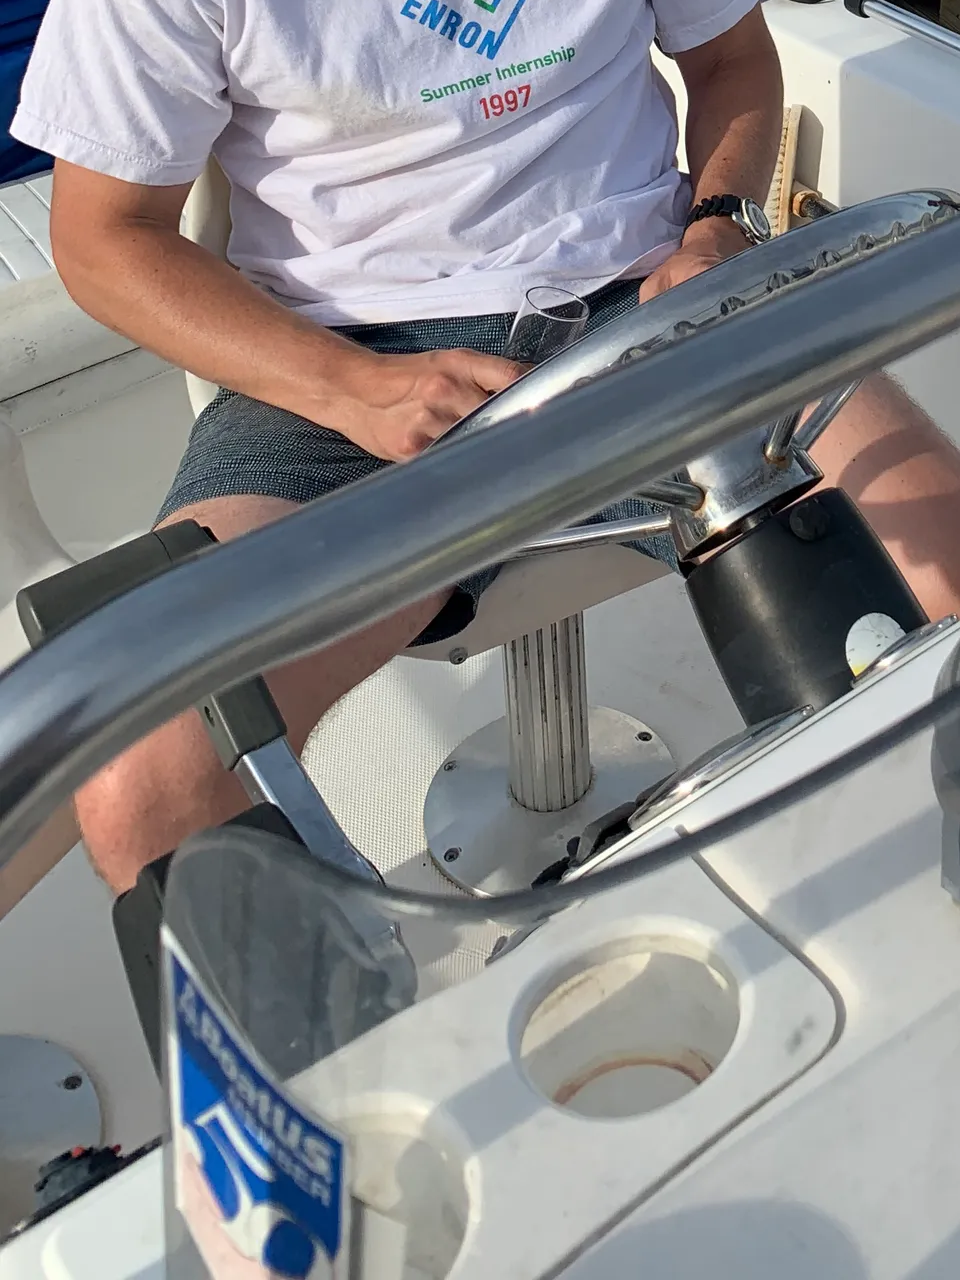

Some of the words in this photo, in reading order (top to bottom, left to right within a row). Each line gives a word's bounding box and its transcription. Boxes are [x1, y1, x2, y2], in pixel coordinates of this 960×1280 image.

[420, 72, 492, 103] Summer
[495, 45, 576, 81] Internship
[479, 84, 532, 120] 1997
